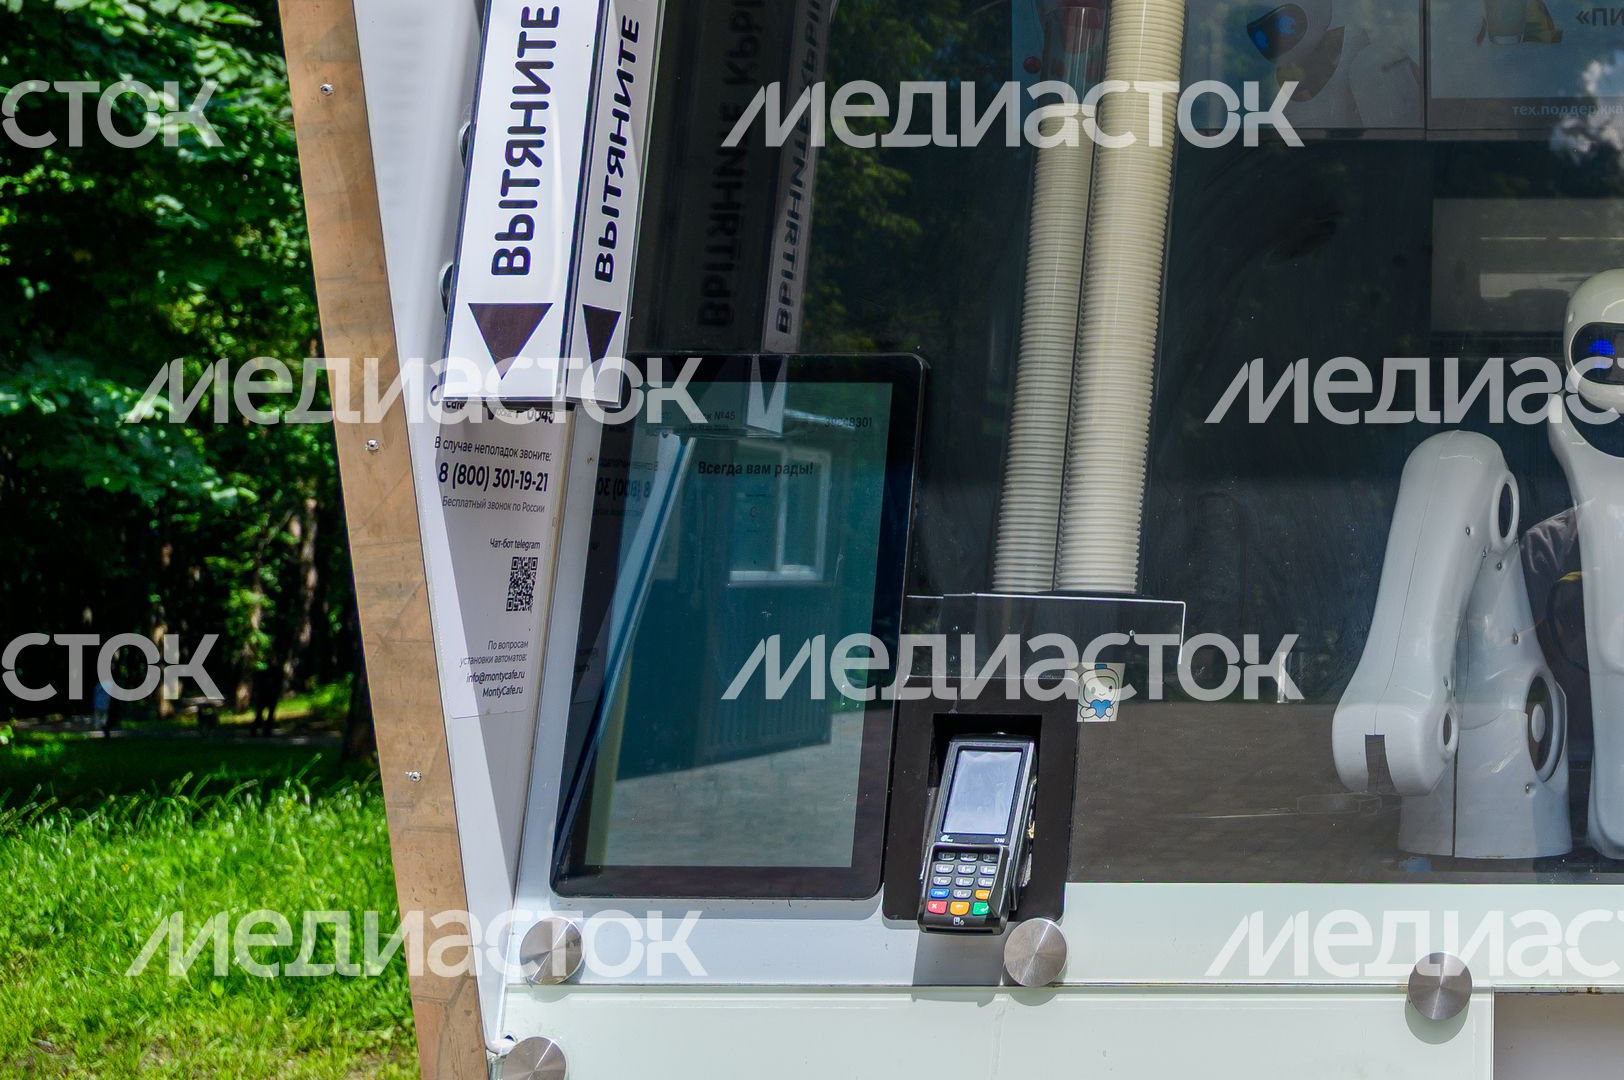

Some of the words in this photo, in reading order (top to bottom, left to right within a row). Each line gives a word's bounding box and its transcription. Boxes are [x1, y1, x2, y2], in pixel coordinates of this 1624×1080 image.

[491, 5, 560, 276] ВЫТЯНИТЕ
[594, 14, 640, 283] ВЫТЯНИТЕ
[434, 436, 441, 449] В
[443, 439, 472, 453] случае
[474, 443, 518, 458] неполадок
[519, 448, 552, 462] звоните:
[438, 462, 449, 483] 8
[452, 462, 490, 492] (800)
[492, 467, 549, 492] 301-19-21
[698, 461, 743, 477] Всегда
[746, 464, 771, 475] вам
[775, 462, 814, 477] рады!
[442, 496, 486, 509] Бесплатный
[487, 500, 511, 510] звонок
[512, 502, 522, 511] по
[522, 502, 545, 513] России
[489, 538, 514, 549] Чат-бот
[514, 539, 541, 551] telegram
[488, 640, 497, 650] По
[498, 640, 528, 652] вопросам
[459, 655, 493, 668] установки
[466, 670, 525, 685] info@montycafe.ru
[482, 685, 523, 699] MontyCafe.ru
